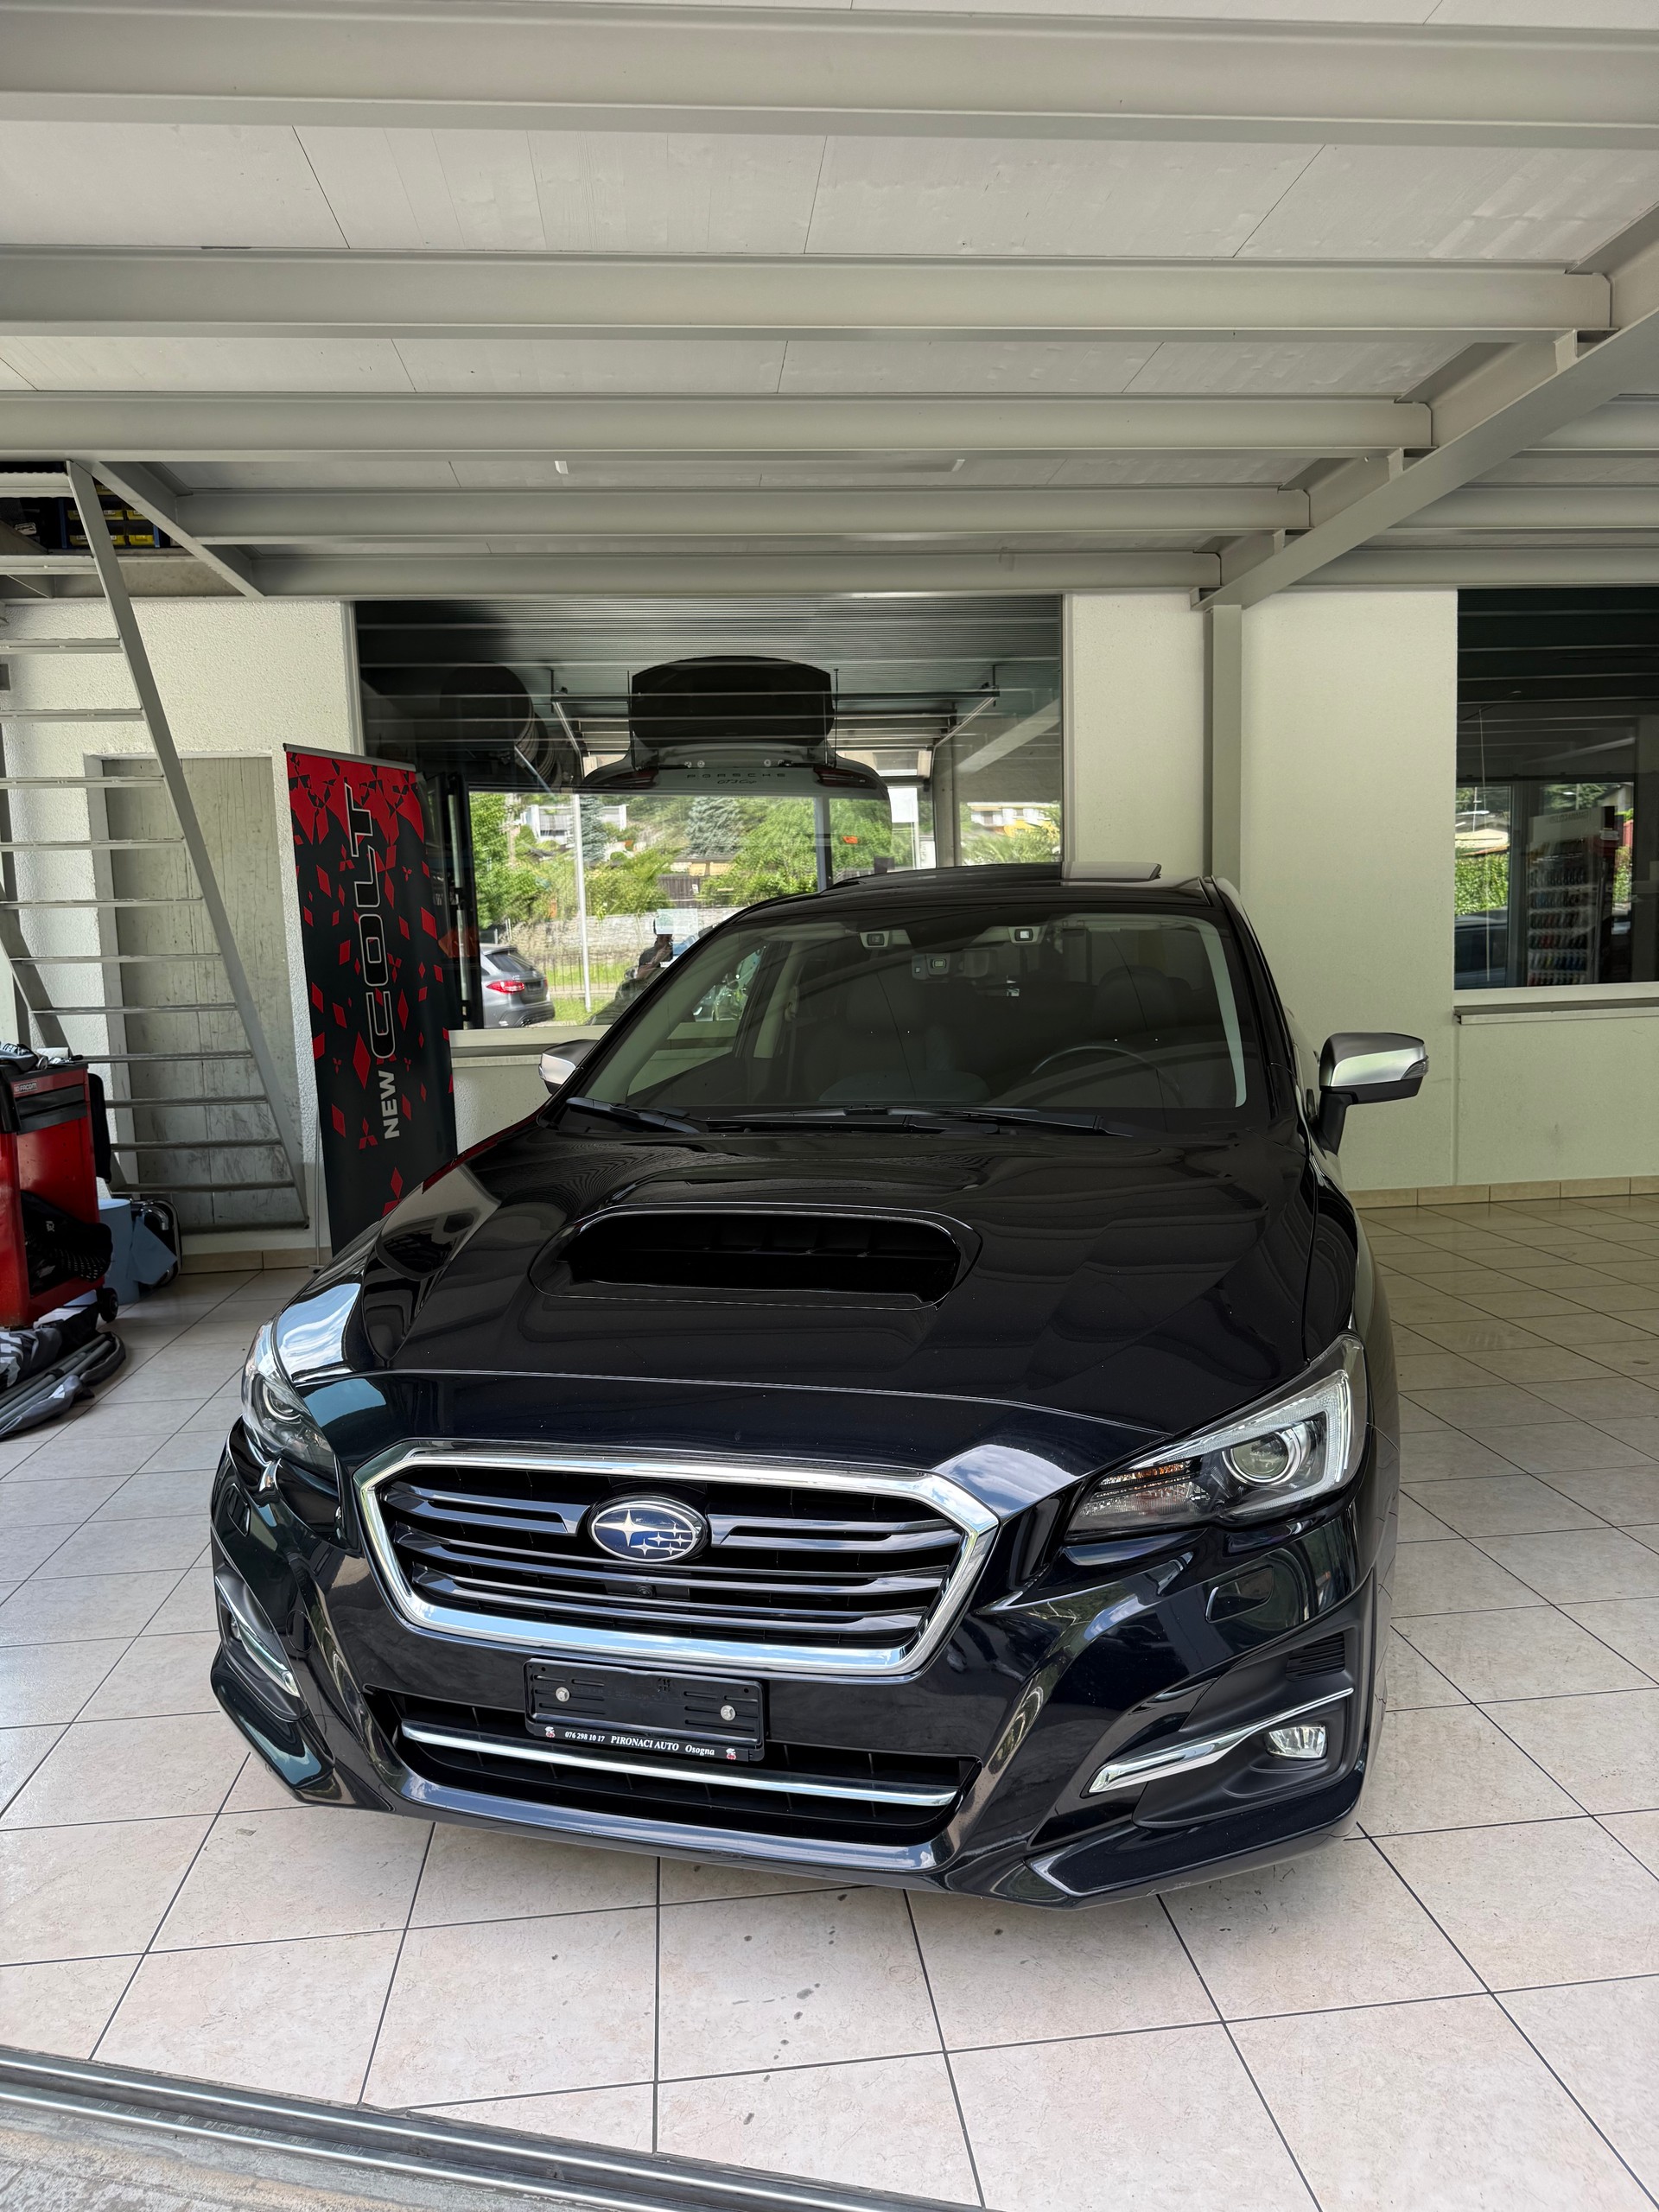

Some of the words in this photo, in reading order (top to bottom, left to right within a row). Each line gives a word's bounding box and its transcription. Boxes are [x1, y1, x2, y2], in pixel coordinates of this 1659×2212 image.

[344, 782, 396, 1058] COLT
[378, 1070, 400, 1140] NEW
[564, 1731, 576, 1739] 076
[610, 1735, 653, 1748] PIRONACI
[654, 1741, 680, 1751] AUTO
[684, 1745, 715, 1756] Osogna
